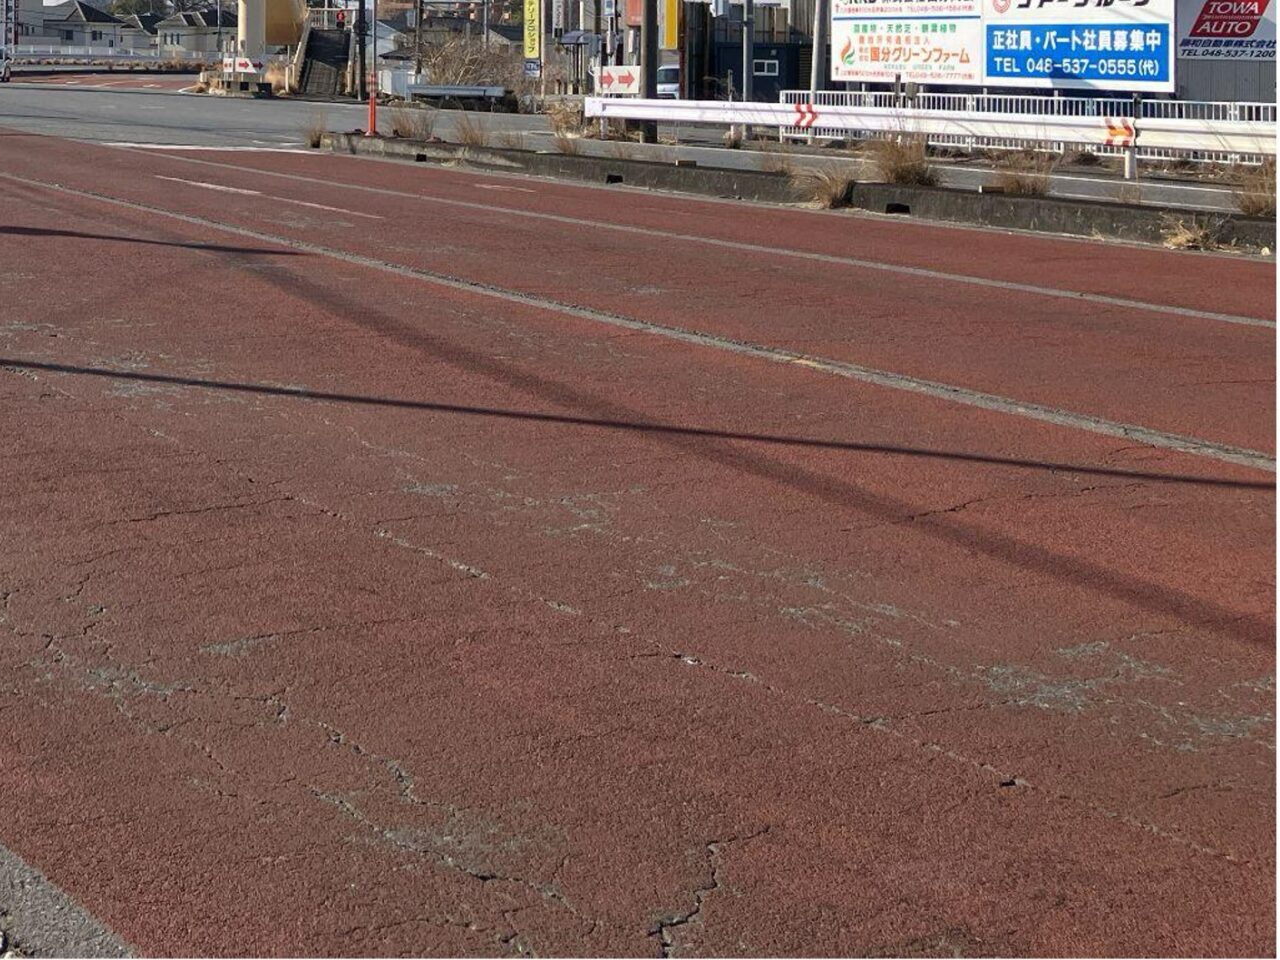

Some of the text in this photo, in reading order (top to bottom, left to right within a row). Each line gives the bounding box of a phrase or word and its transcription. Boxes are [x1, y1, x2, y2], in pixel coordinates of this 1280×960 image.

[1209, 1, 1260, 14] TOWA
[1196, 21, 1252, 33] AUTO
[992, 29, 1161, 51] 正社員・パート社員募集中
[870, 47, 970, 63] 国分グリーンファーム
[994, 57, 1020, 72] TEL
